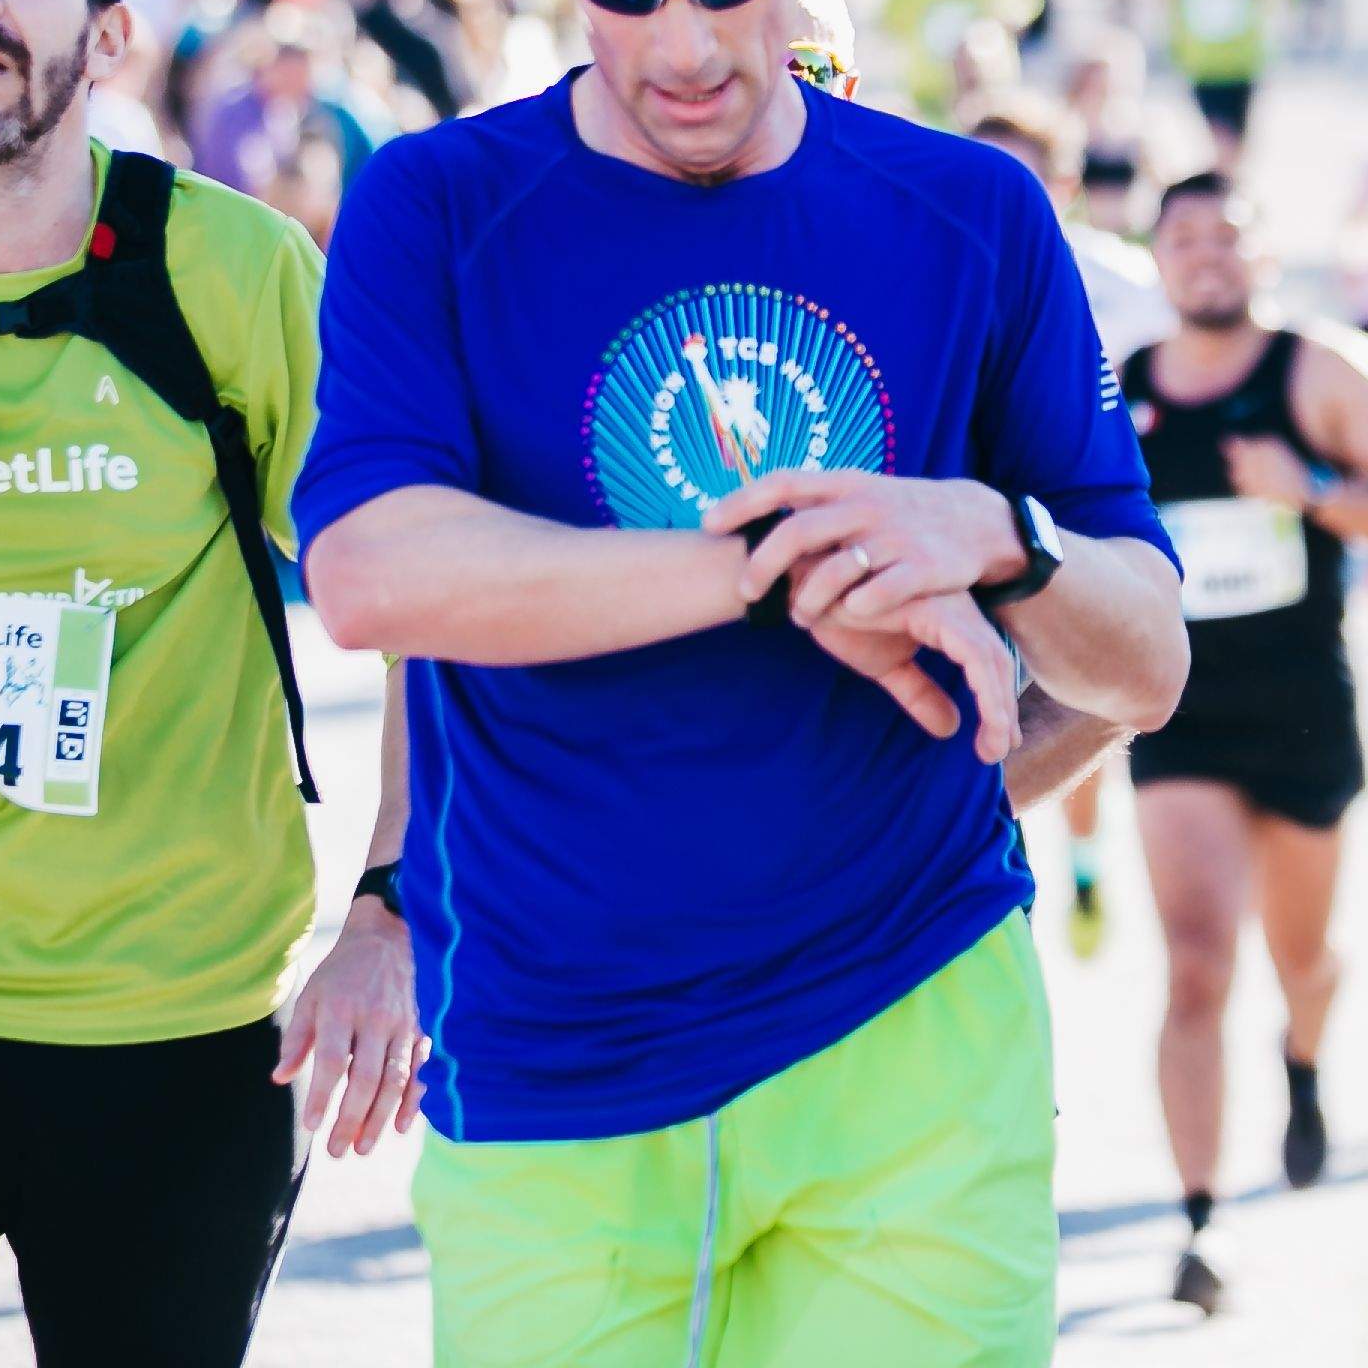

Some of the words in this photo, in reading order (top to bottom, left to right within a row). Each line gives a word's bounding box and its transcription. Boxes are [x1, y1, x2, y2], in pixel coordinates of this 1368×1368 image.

[718, 336, 778, 366] TCS
[780, 359, 828, 413] NEW
[800, 419, 830, 473] YOR
